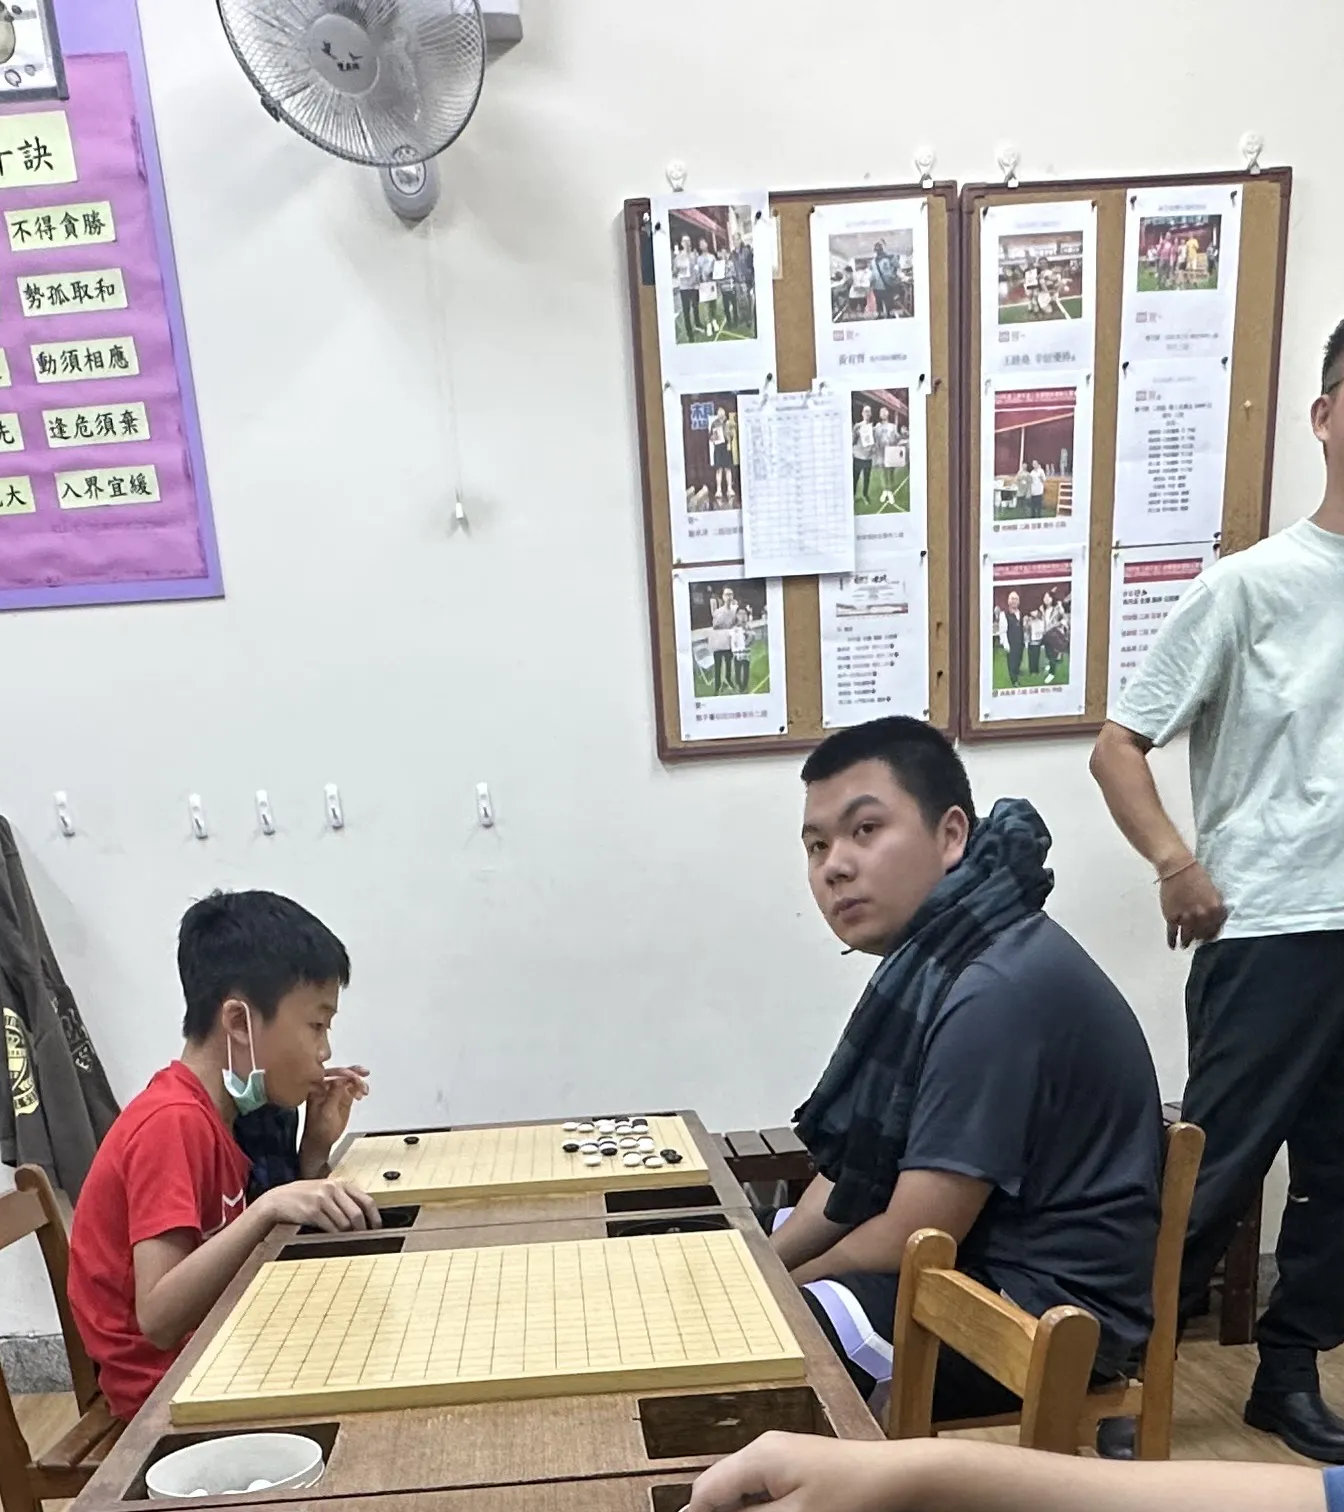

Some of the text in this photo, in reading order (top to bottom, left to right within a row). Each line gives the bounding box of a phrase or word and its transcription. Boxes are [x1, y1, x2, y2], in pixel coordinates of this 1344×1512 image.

[11, 209, 106, 244] 不得貪勝
[23, 277, 116, 310] 勢孤取和
[35, 344, 130, 375] 動須相應
[49, 409, 139, 440] 逢危須棄
[61, 472, 152, 501] 入界宜緩
